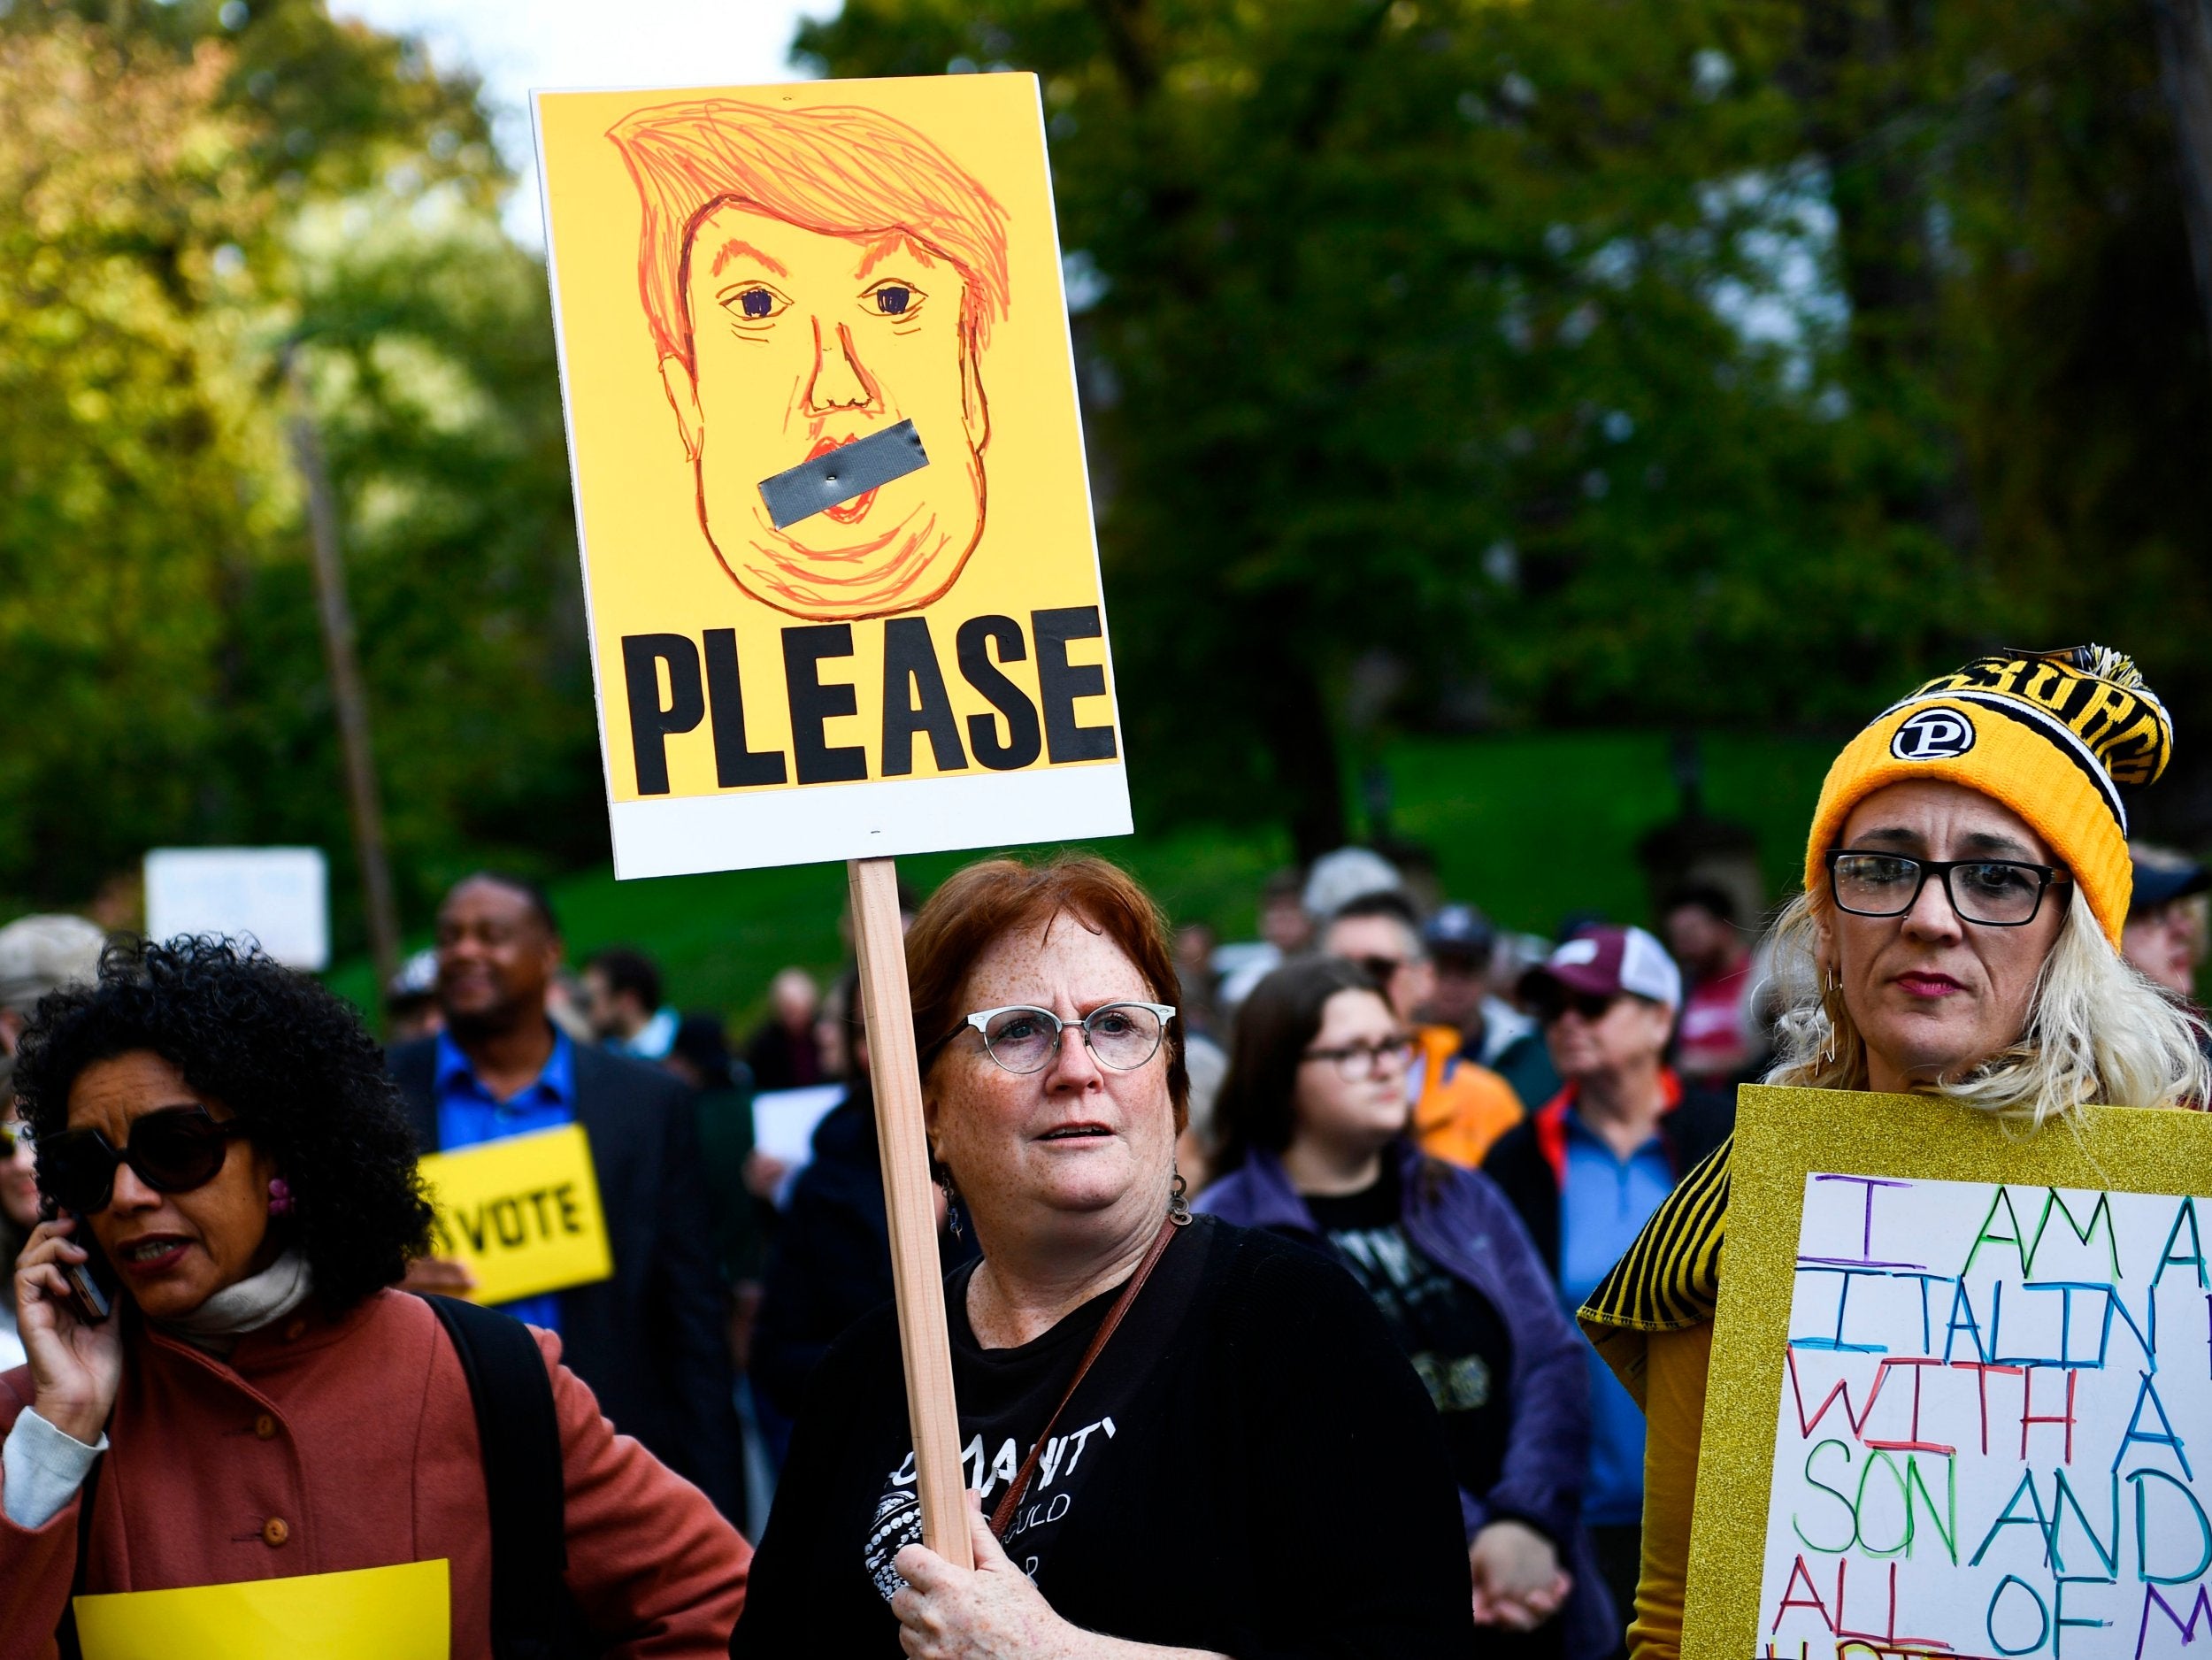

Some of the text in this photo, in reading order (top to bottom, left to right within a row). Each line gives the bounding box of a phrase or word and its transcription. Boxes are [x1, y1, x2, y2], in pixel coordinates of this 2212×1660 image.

[621, 605, 1118, 795] PLEASE
[455, 1180, 583, 1254] VOTE
[1796, 1173, 2211, 1289] I AM A
[1786, 1343, 2194, 1482] WITH A
[1793, 1439, 2212, 1586] SON AND
[1772, 1554, 1955, 1653] ALL
[1986, 1575, 2116, 1660] OF
